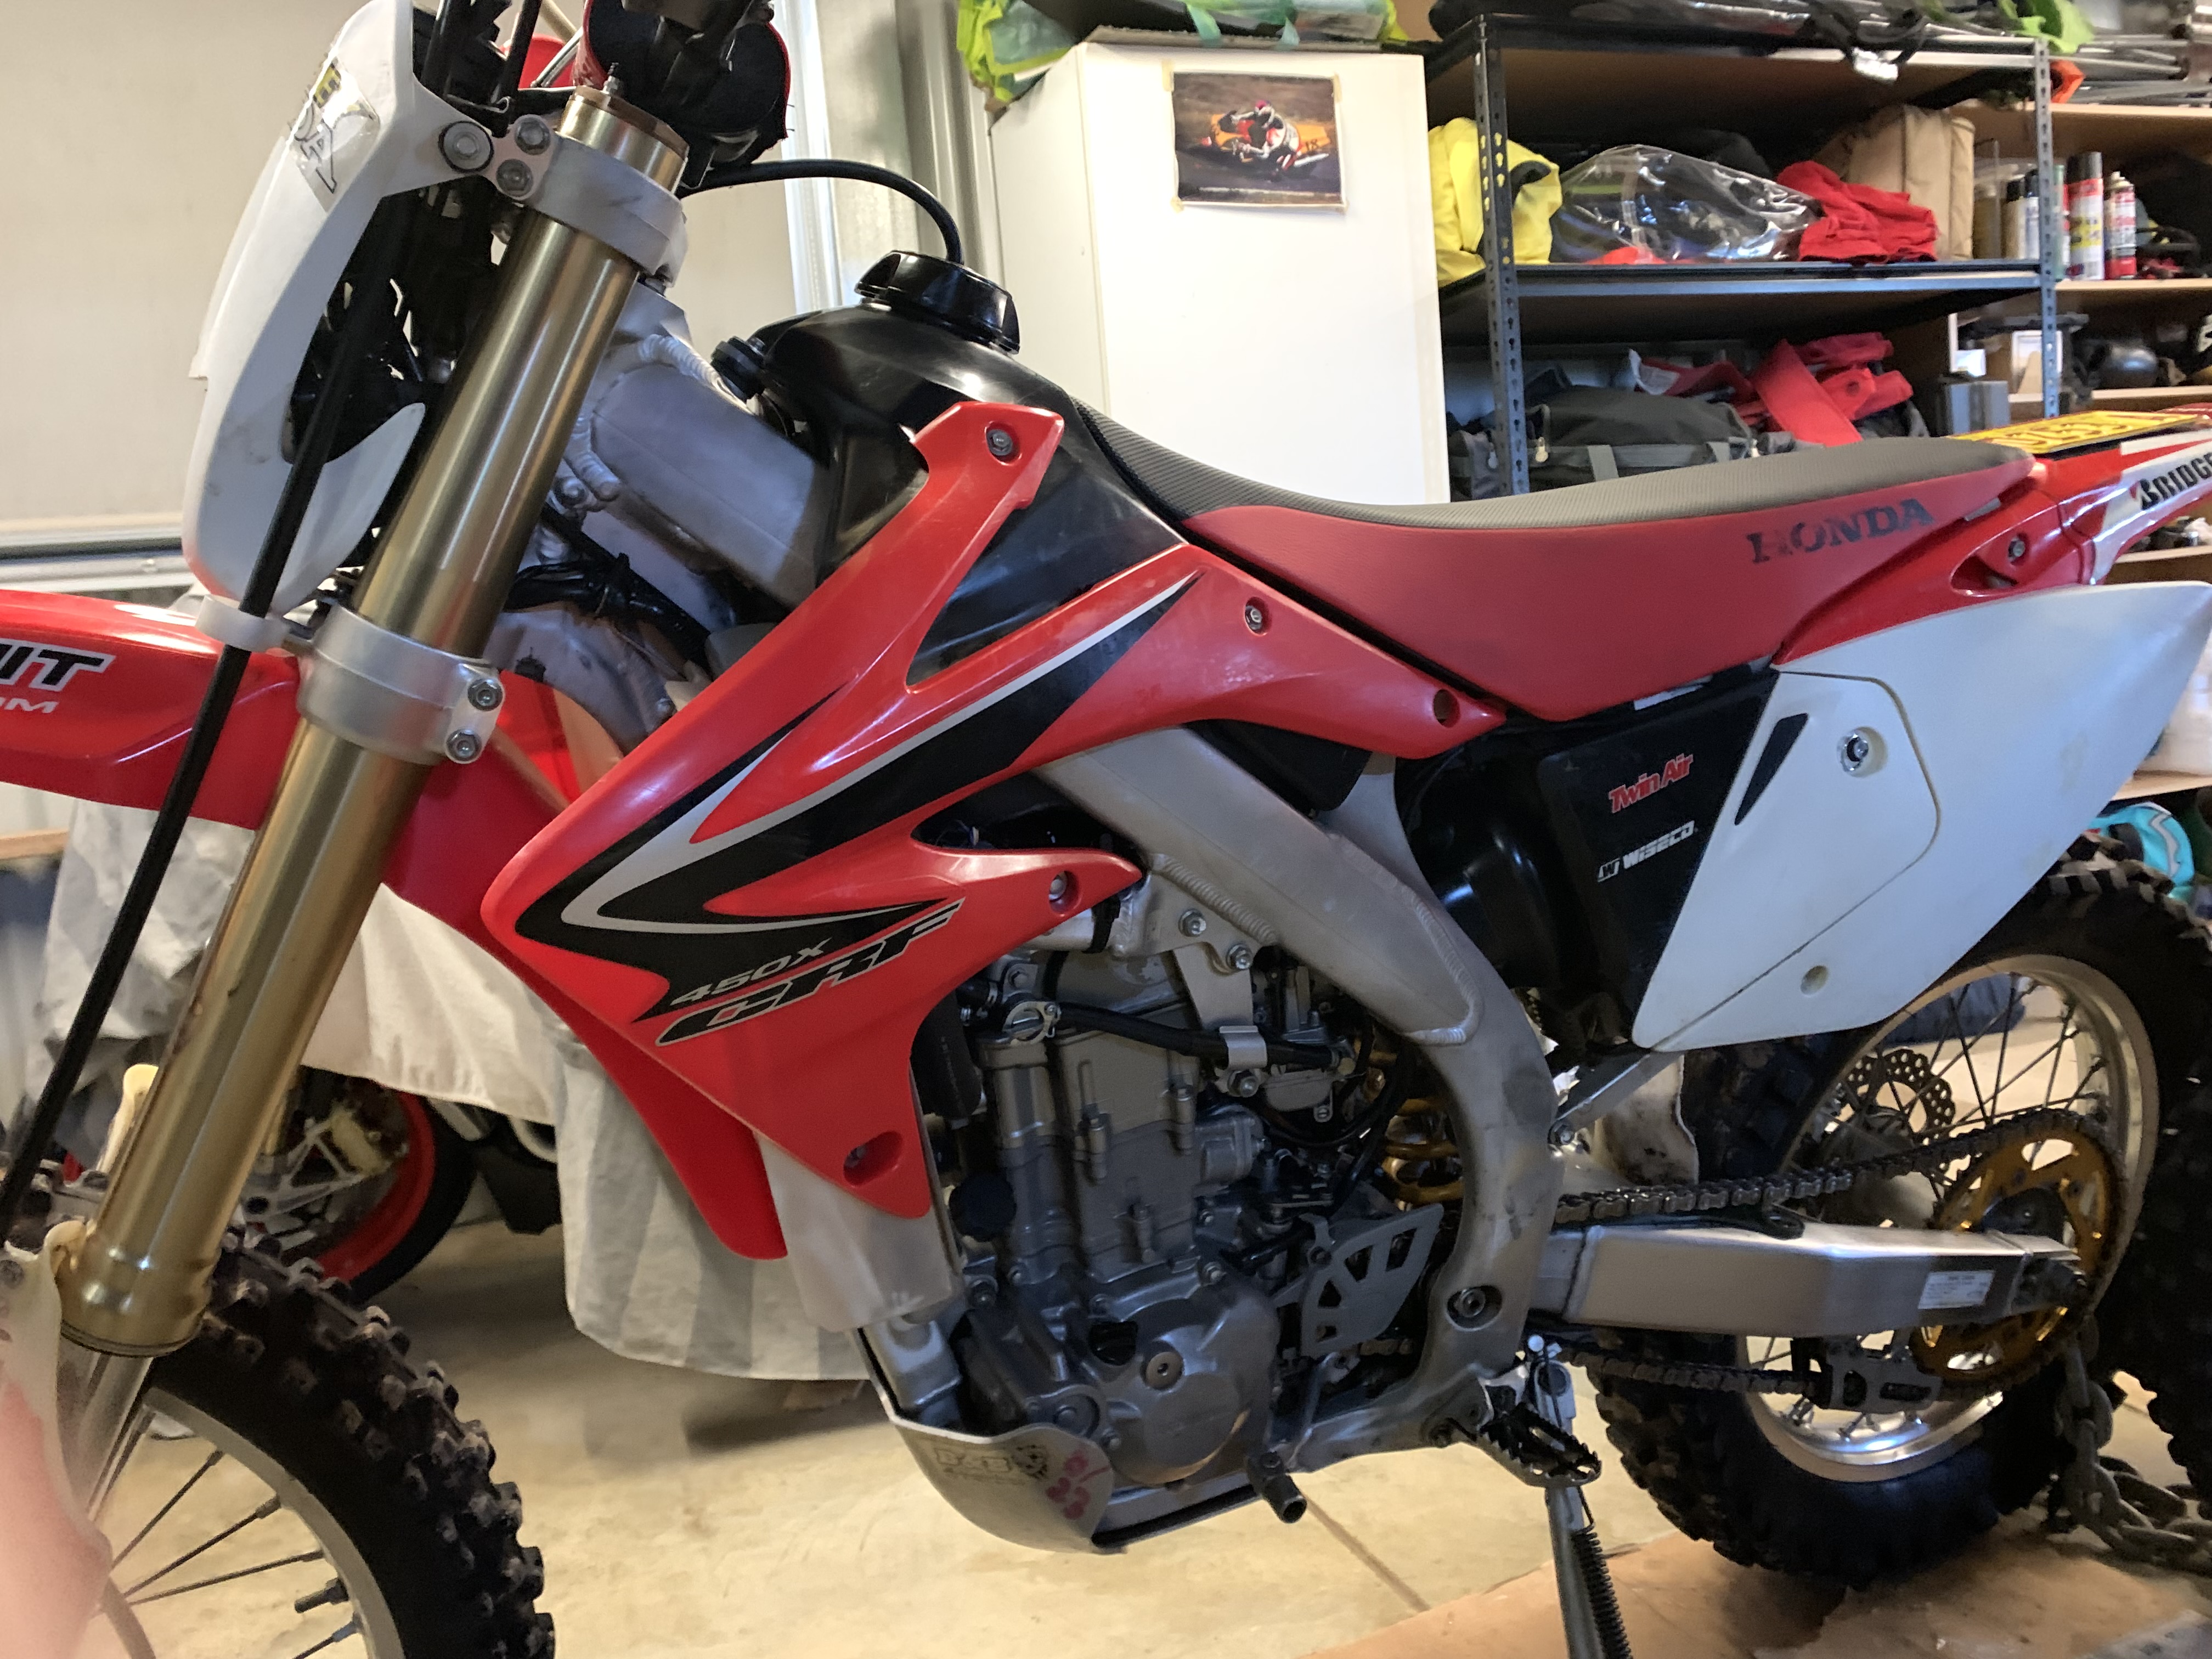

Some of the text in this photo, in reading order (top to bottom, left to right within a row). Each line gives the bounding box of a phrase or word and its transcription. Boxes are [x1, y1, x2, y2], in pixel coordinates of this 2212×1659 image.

[1608, 753, 1694, 814] Twin Air
[655, 897, 966, 1046] CRF
[670, 937, 832, 1006] 450X
